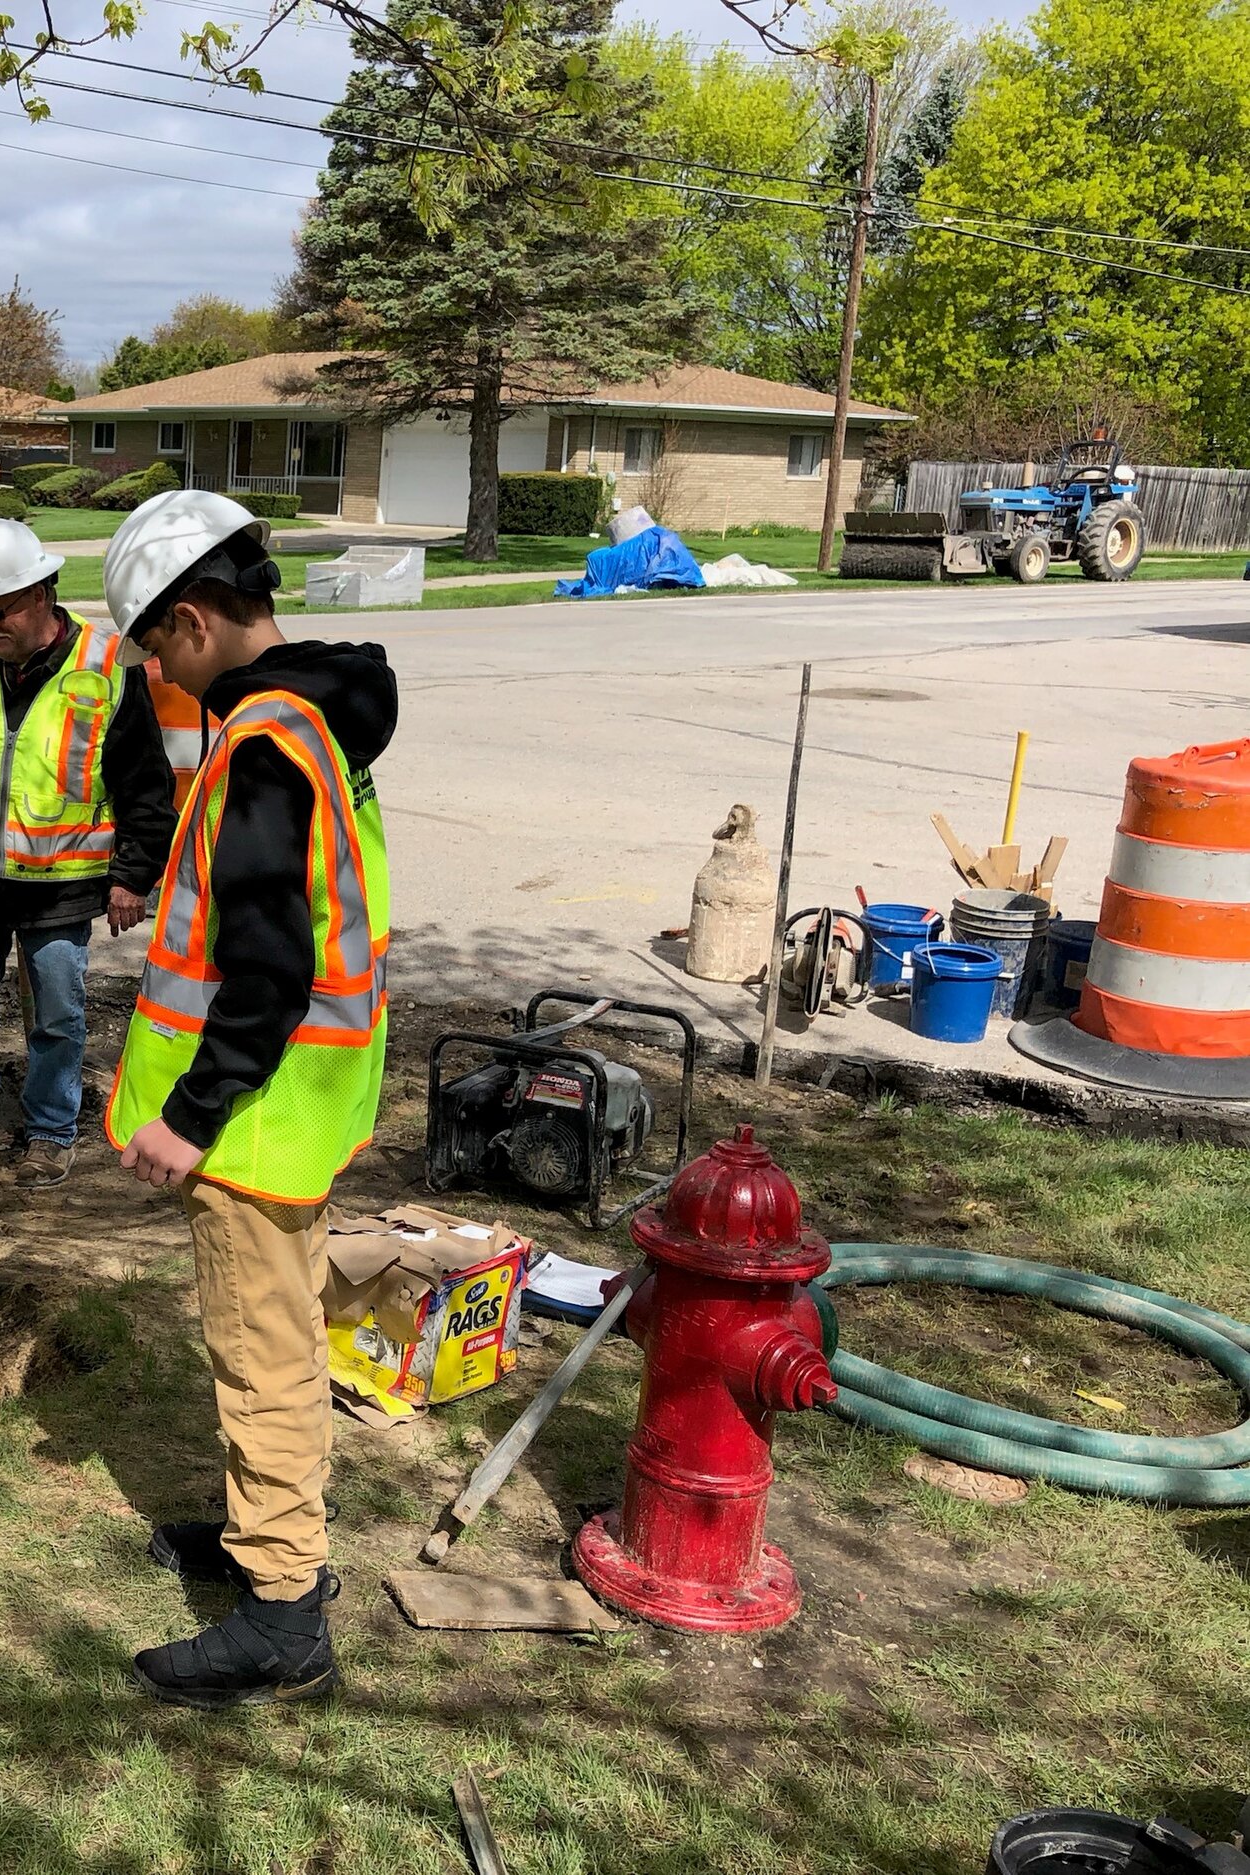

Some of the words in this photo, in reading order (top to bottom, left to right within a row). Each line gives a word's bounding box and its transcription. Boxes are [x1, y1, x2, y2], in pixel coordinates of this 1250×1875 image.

[540, 1074, 582, 1088] HONDA
[444, 1294, 503, 1342] RAGS
[499, 1348, 517, 1368] 350
[403, 1372, 427, 1396] 350
